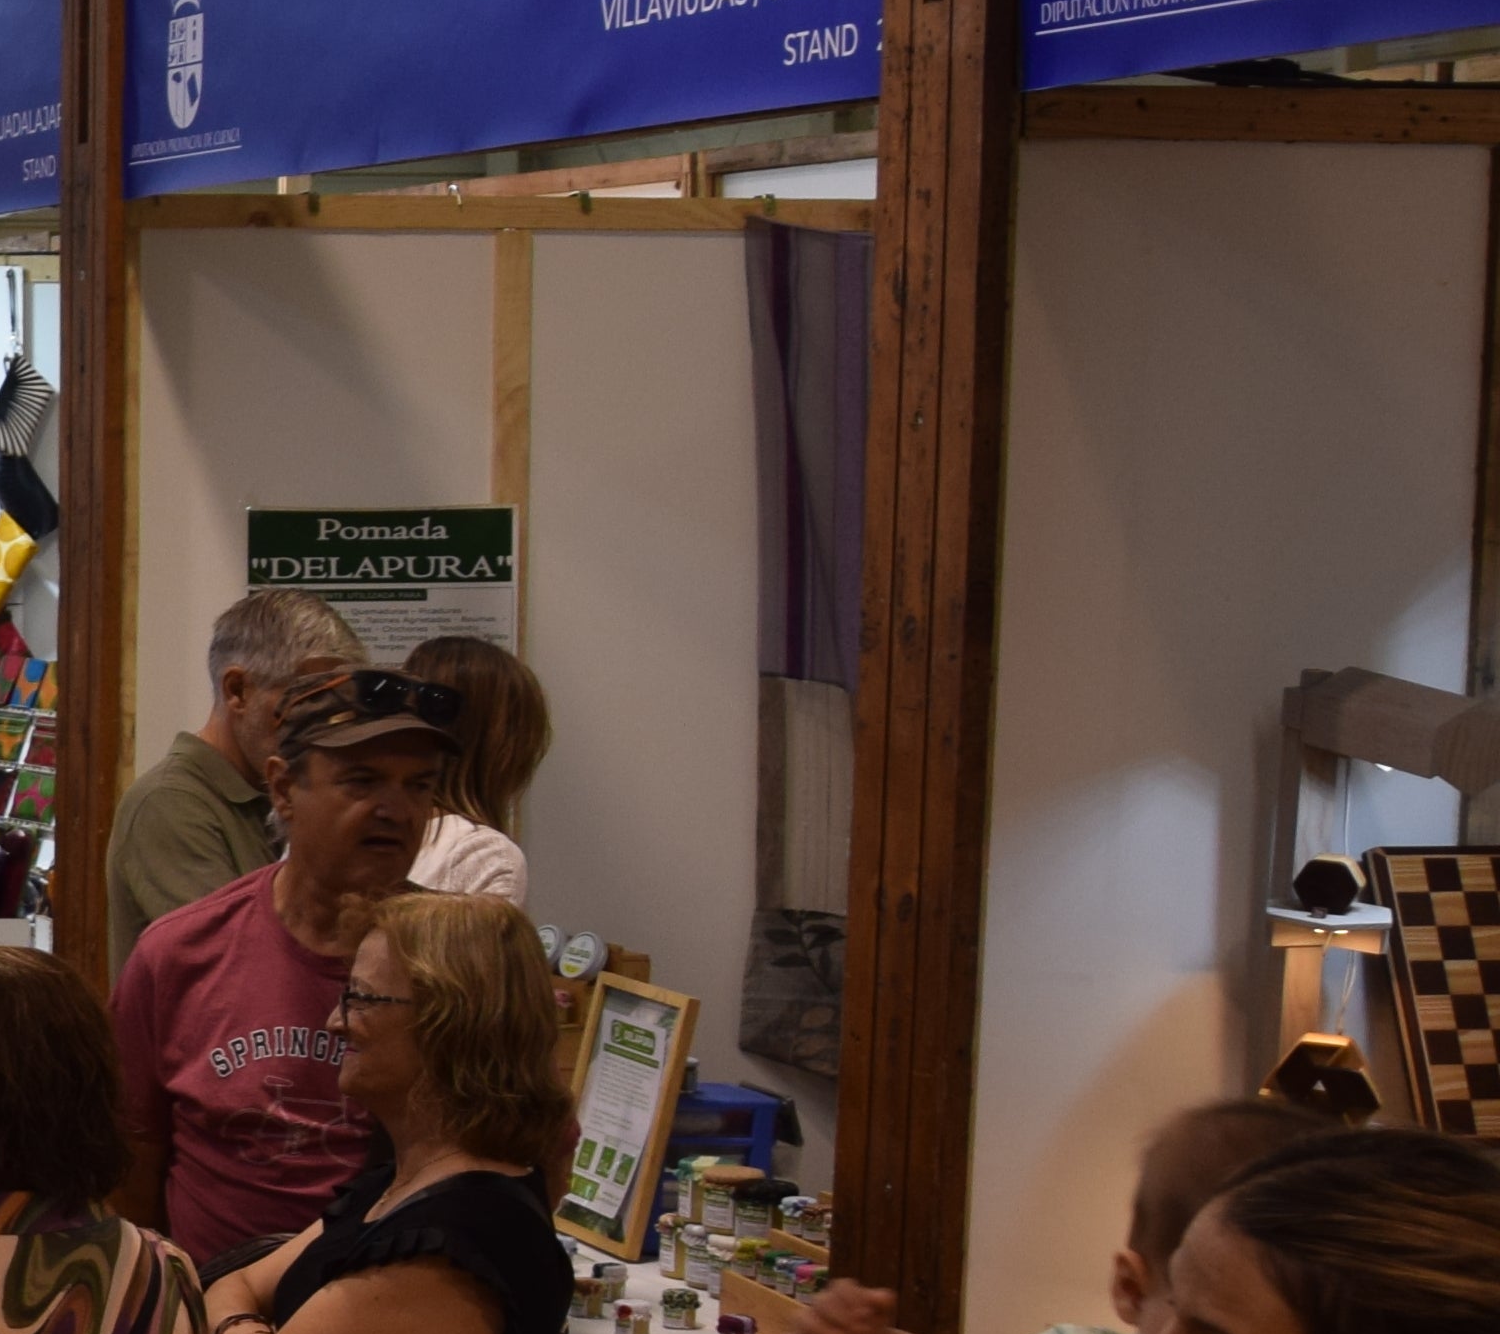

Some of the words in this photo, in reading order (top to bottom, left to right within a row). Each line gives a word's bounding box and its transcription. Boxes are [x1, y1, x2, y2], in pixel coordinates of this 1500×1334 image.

[783, 23, 859, 65] STAND
[22, 154, 56, 181] STAND
[317, 517, 449, 541] Pomada
[251, 555, 512, 580] "DELAPURA"
